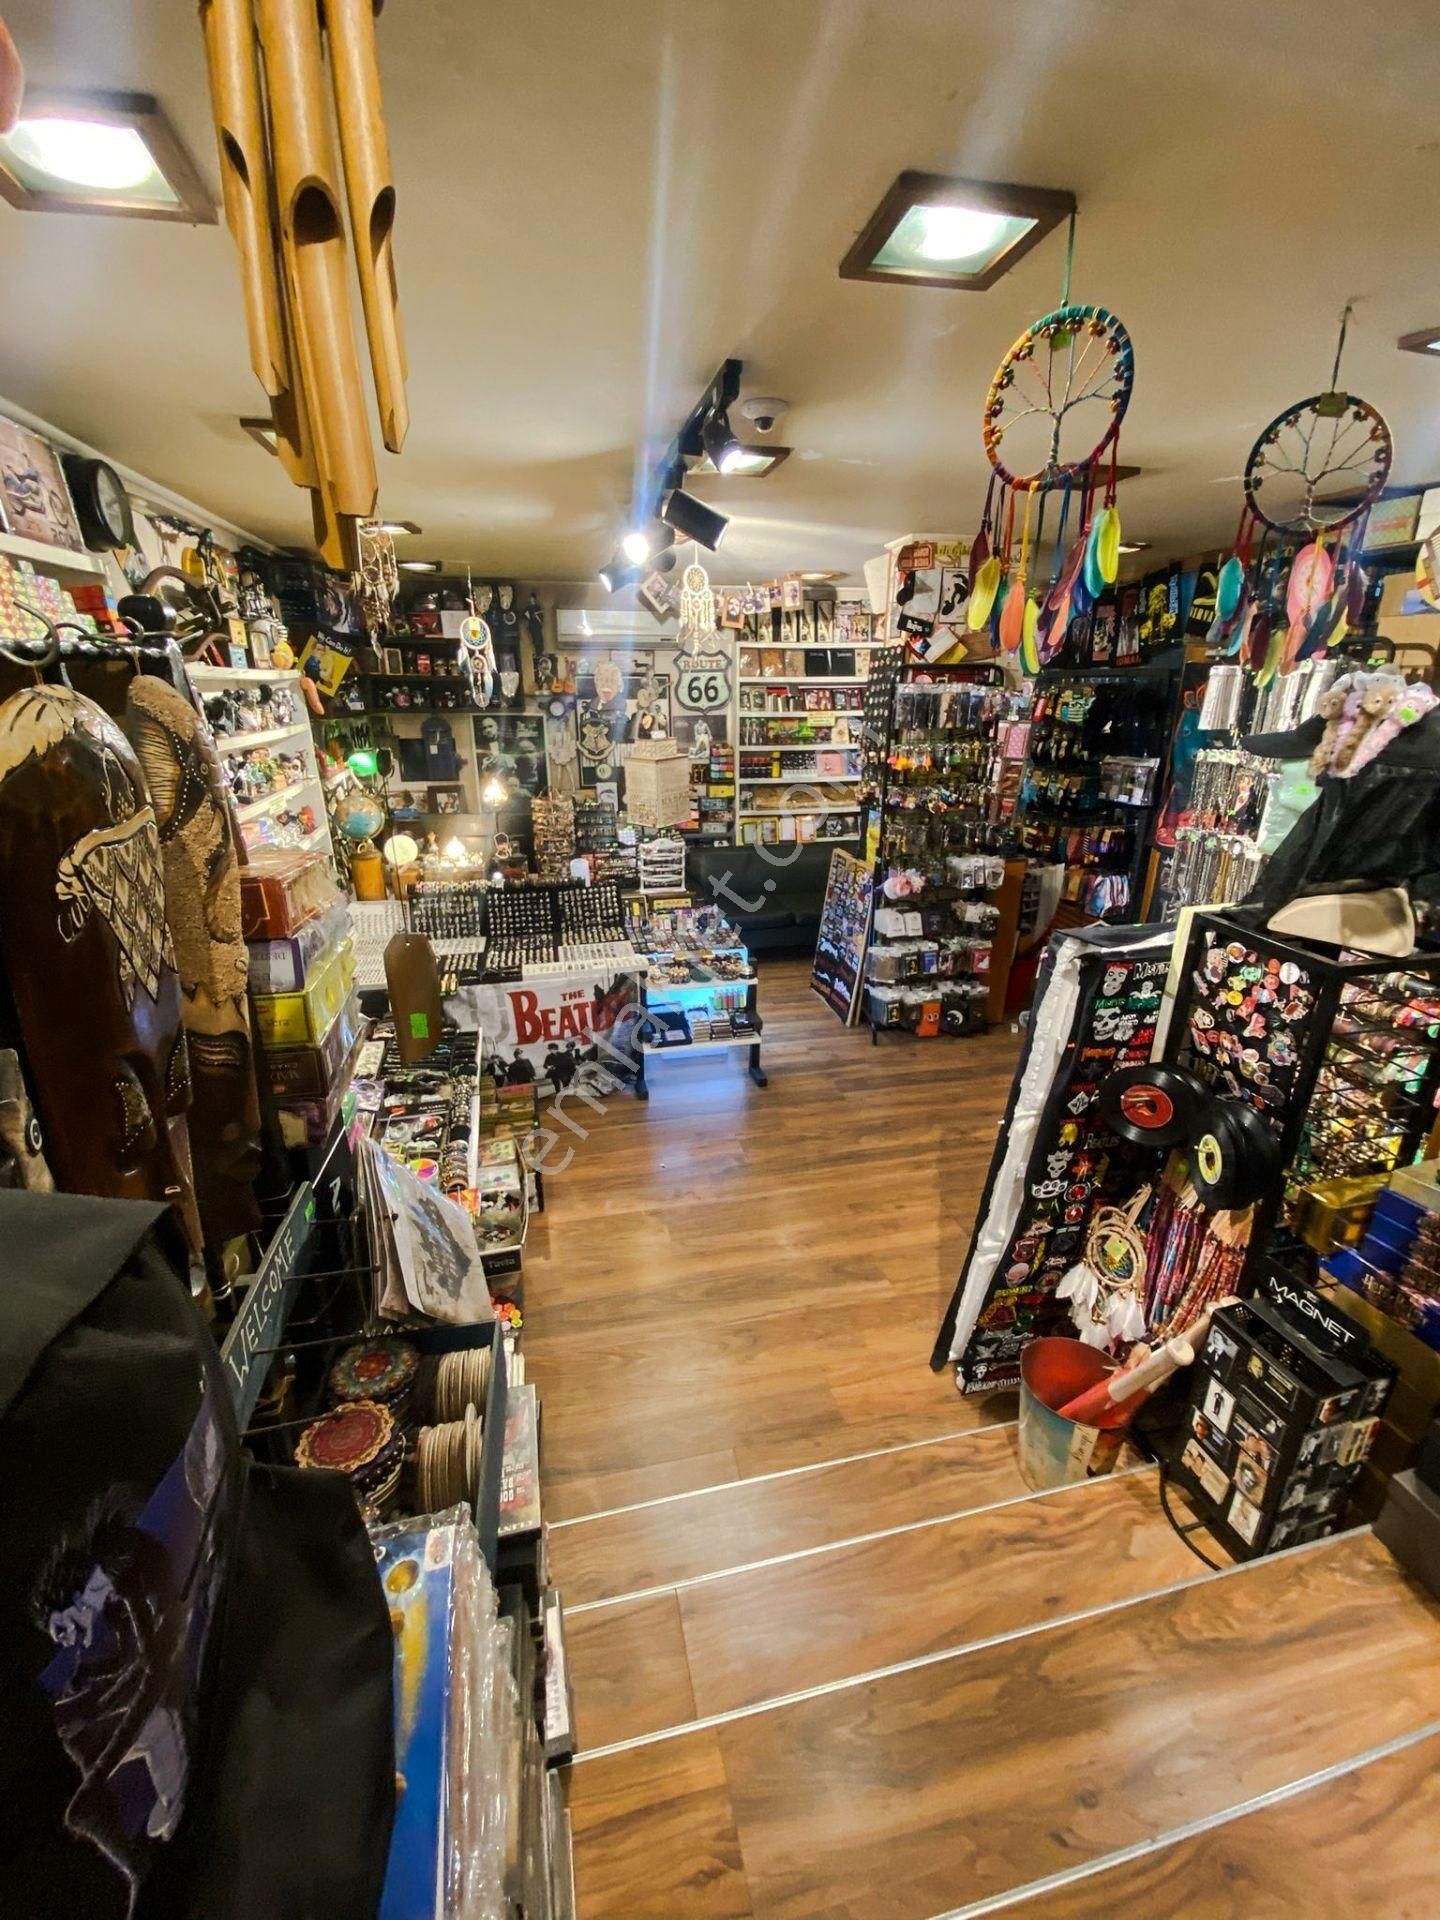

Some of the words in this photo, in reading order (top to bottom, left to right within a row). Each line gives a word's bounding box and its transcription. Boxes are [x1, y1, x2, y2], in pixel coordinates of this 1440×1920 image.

[683, 659, 722, 669] ROUTE
[688, 676, 719, 703] 66
[560, 989, 585, 1002] THE
[506, 989, 638, 1046] BEATL
[229, 1227, 295, 1388] WELCOME
[1269, 1276, 1356, 1343] MAGNET
